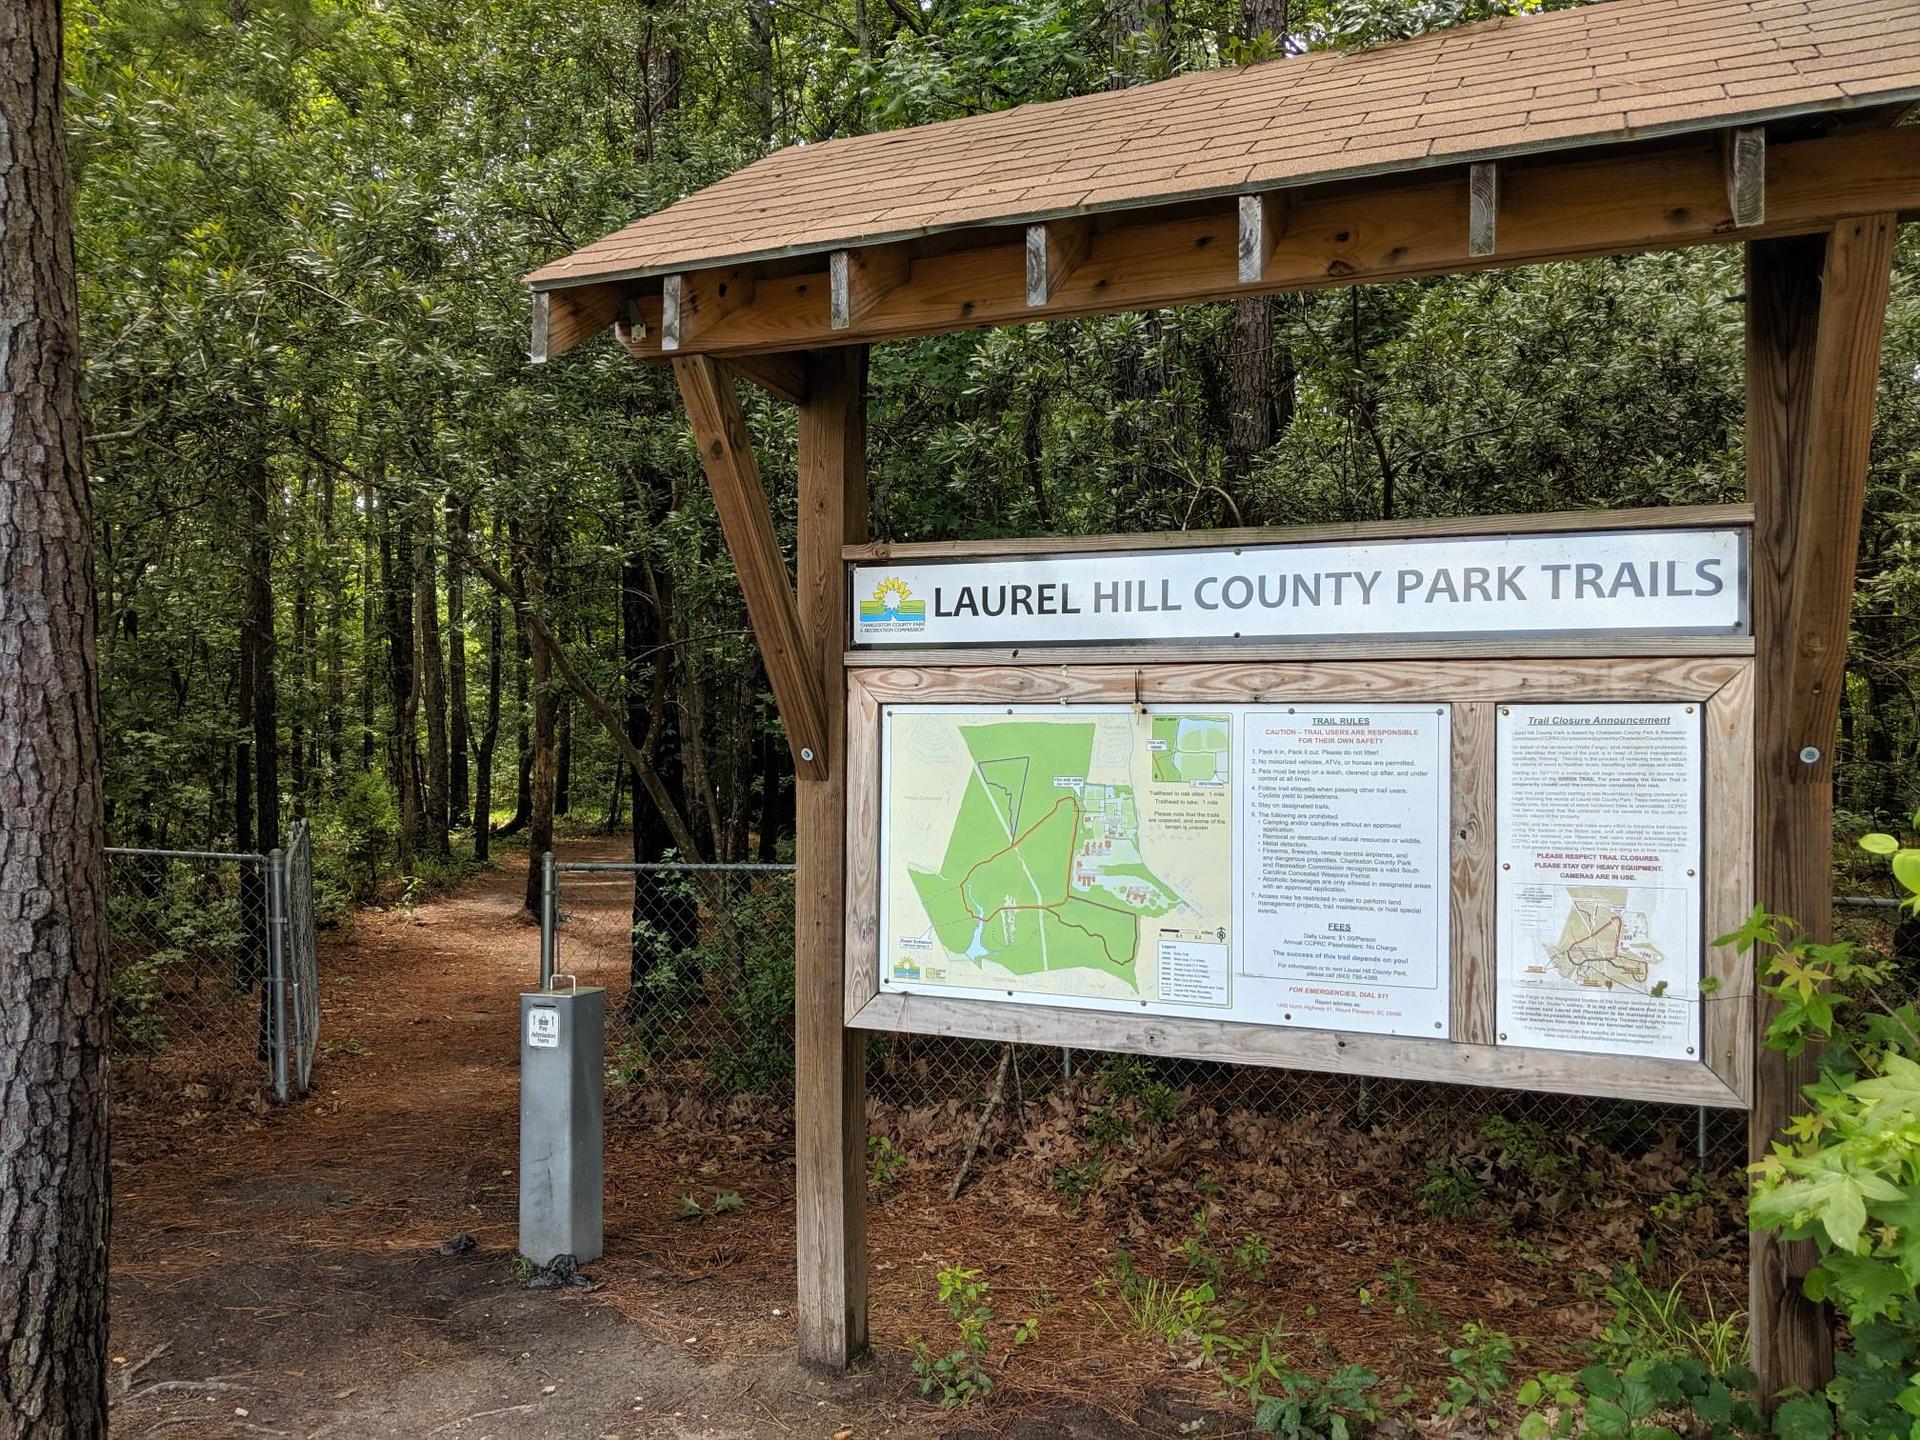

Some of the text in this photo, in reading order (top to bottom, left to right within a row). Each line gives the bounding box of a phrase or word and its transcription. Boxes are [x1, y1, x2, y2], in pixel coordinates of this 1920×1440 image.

[934, 558, 1724, 617] LAUREL HILL COUNTY PARK TRAILS
[1340, 718, 1370, 726] RULES
[1528, 716, 1671, 725] Trail Closure Announcement
[1328, 923, 1351, 932] FEES
[1352, 955, 1381, 963] depends
[1305, 988, 1357, 997] EMERGENCIES,
